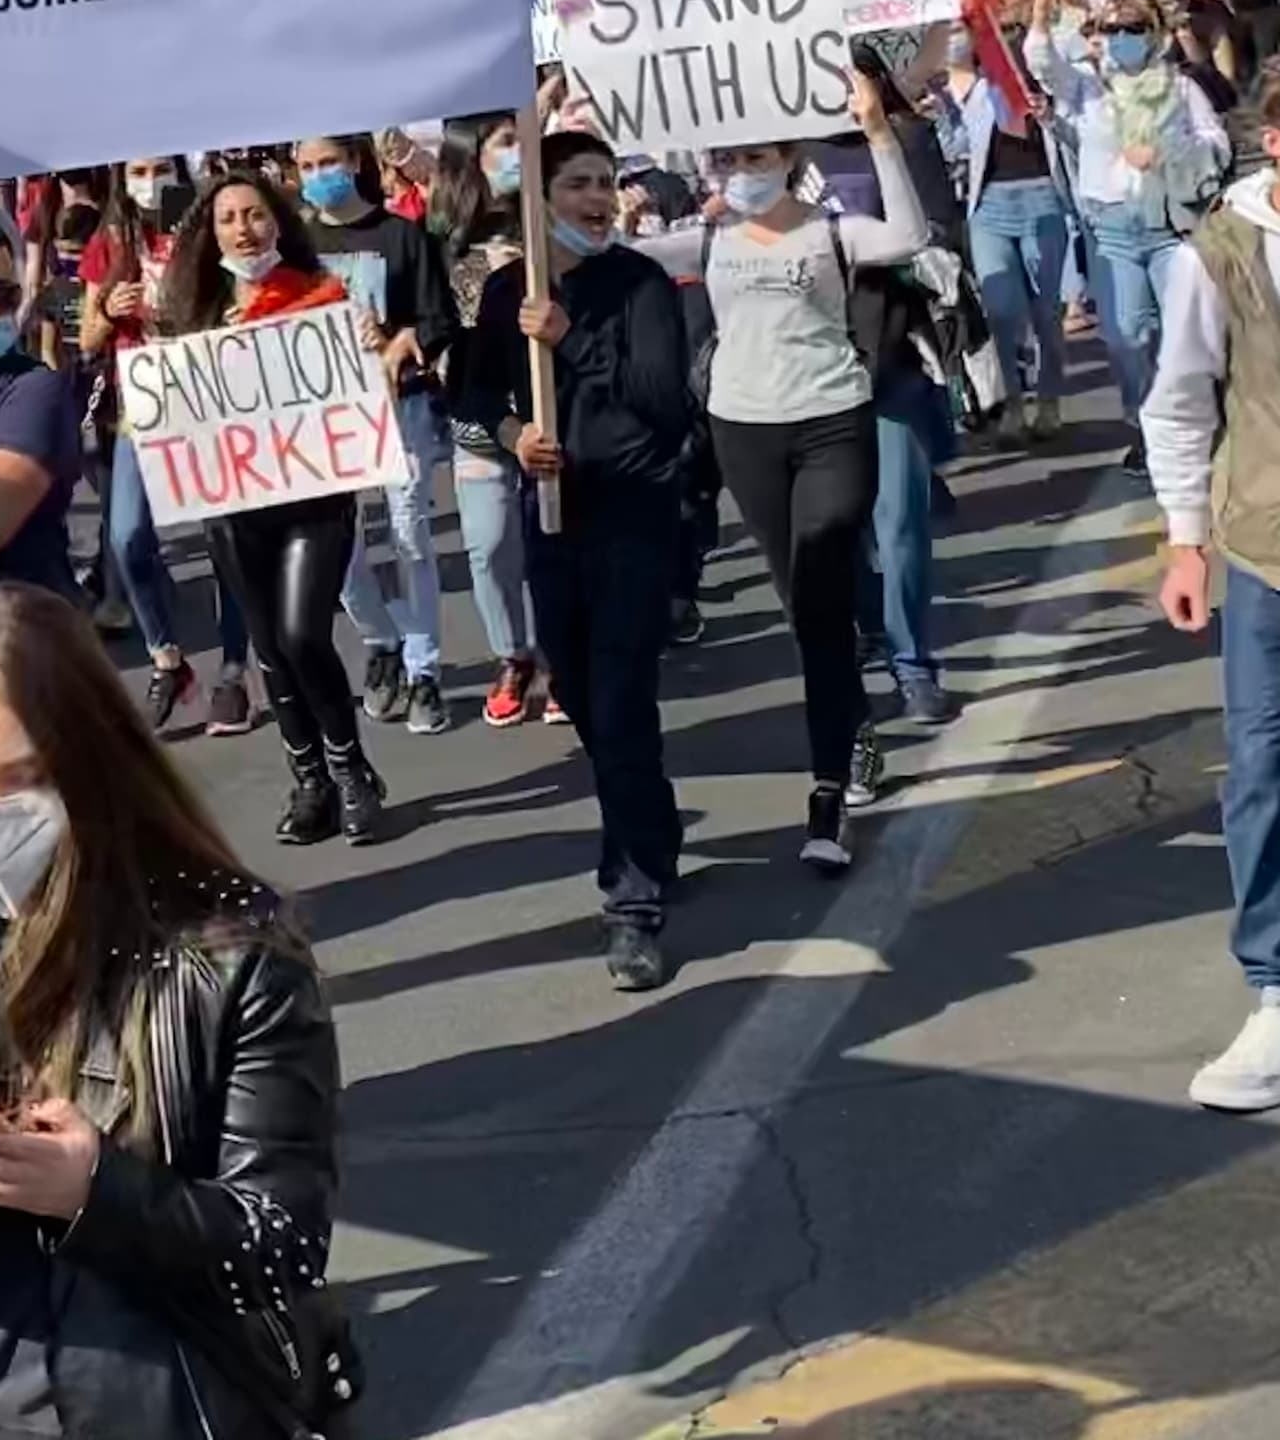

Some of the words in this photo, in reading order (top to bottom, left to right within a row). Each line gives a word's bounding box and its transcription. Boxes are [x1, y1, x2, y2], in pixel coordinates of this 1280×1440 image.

[571, 39, 745, 144] WITH
[766, 29, 855, 117] US
[129, 310, 368, 431] SANCTION
[141, 401, 389, 508] TURKEY
